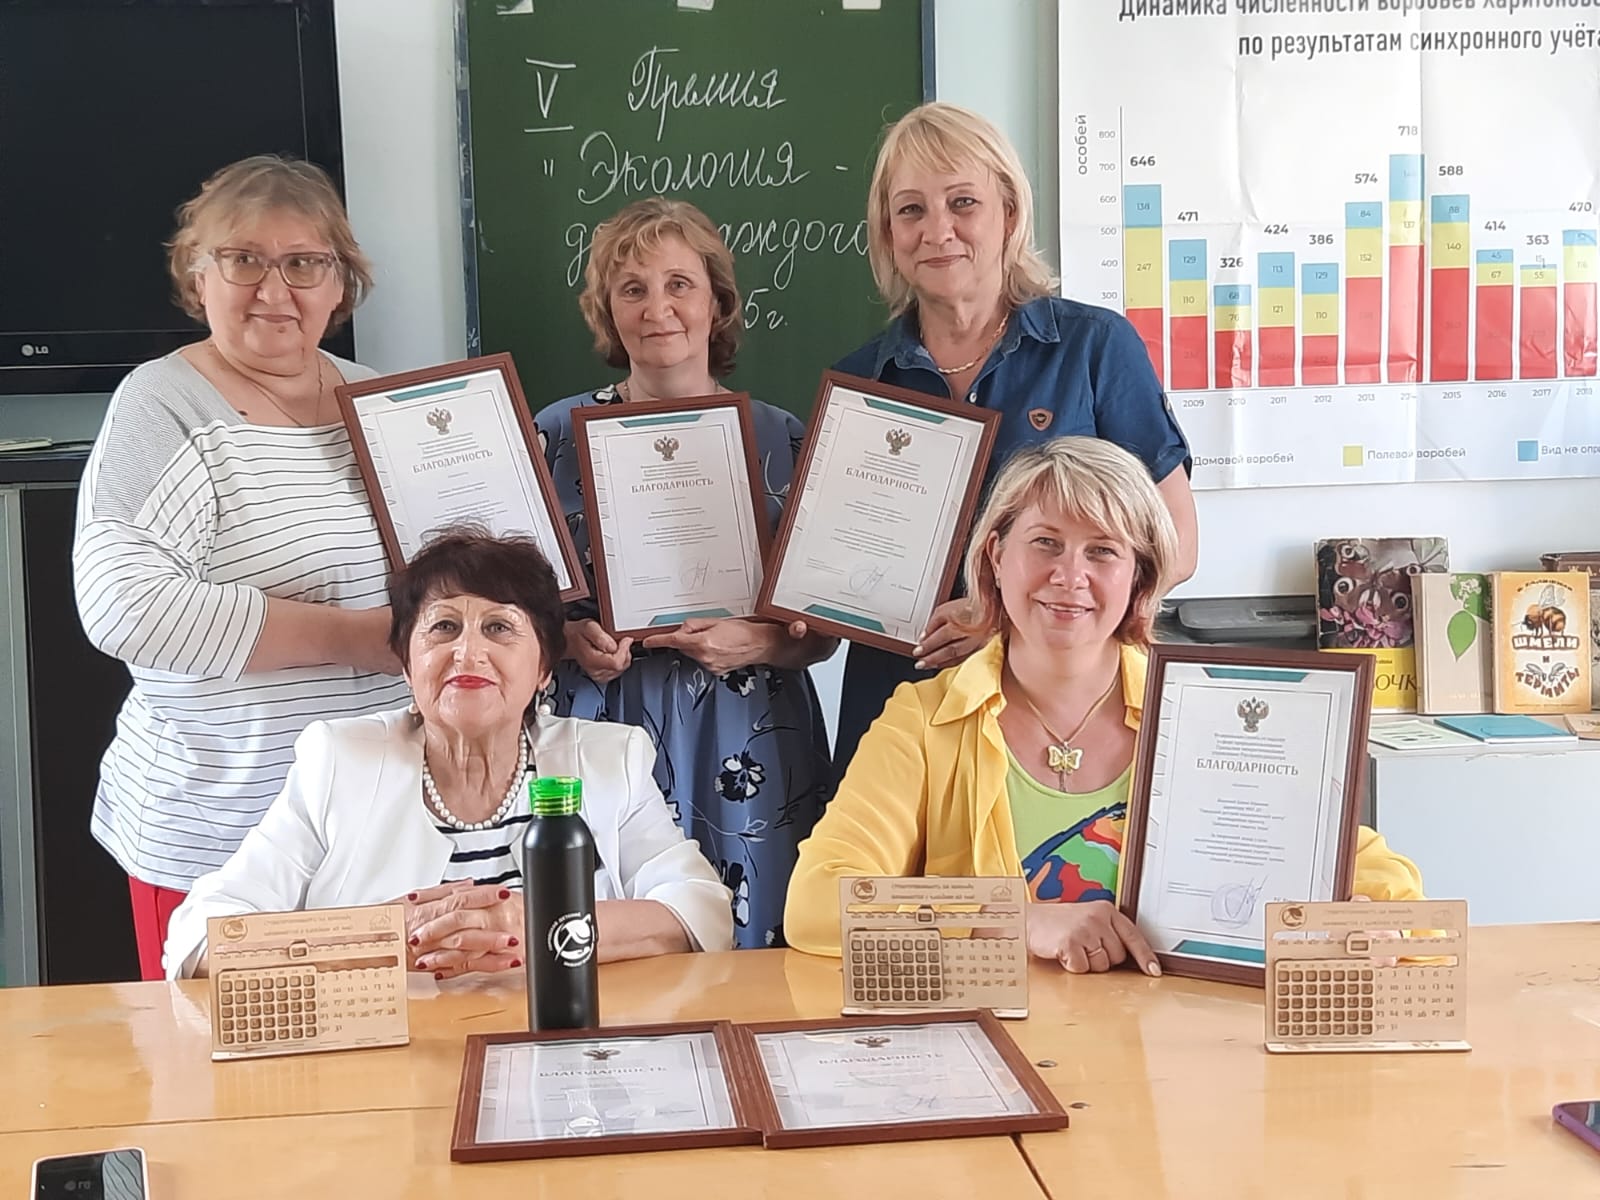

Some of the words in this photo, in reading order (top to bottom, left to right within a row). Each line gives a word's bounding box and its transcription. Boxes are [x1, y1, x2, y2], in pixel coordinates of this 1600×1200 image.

[1239, 36, 1262, 55] по
[1272, 32, 1401, 61] результатам
[1410, 29, 1542, 56] синхронного
[628, 46, 786, 141] Премия
[1398, 126, 1418, 136] 718
[1075, 115, 1087, 175] особей
[1130, 156, 1156, 166] 646
[1099, 163, 1115, 171] 700
[1438, 166, 1464, 176] 588
[1354, 173, 1378, 184] 574
[1100, 195, 1116, 203] 600
[1569, 202, 1592, 212] 470
[1177, 211, 1198, 222] 471
[1101, 227, 1117, 235] 500
[1264, 225, 1289, 235] 424
[1484, 220, 1506, 231] 414
[1309, 235, 1334, 245] 386
[1526, 235, 1550, 245] 363
[718, 218, 870, 290] ждого
[1136, 263, 1151, 271] 247
[1220, 257, 1244, 268] 326
[1101, 292, 1118, 300] 300
[1183, 400, 1205, 408] 2009
[1270, 396, 1287, 405] 2011
[1314, 395, 1332, 404] 2012
[1442, 391, 1462, 399] 2015
[1487, 390, 1507, 399] 2016
[1532, 388, 1552, 397] 2017
[1416, 447, 1466, 459] воробей
[1541, 445, 1562, 456] Вид
[412, 449, 493, 474] БЛАГОДАРНОСТЬ
[1246, 453, 1294, 465] воробей
[631, 478, 714, 494] БЛАГОДАРНОСТЬ
[845, 467, 928, 495] БЛАГОДАРНОСТЬ
[1513, 636, 1578, 649] ШМЕЛИ
[1515, 667, 1580, 698] ТЕРМИТЫ
[1196, 758, 1299, 776] БЛАГОДАРНОСТЬ
